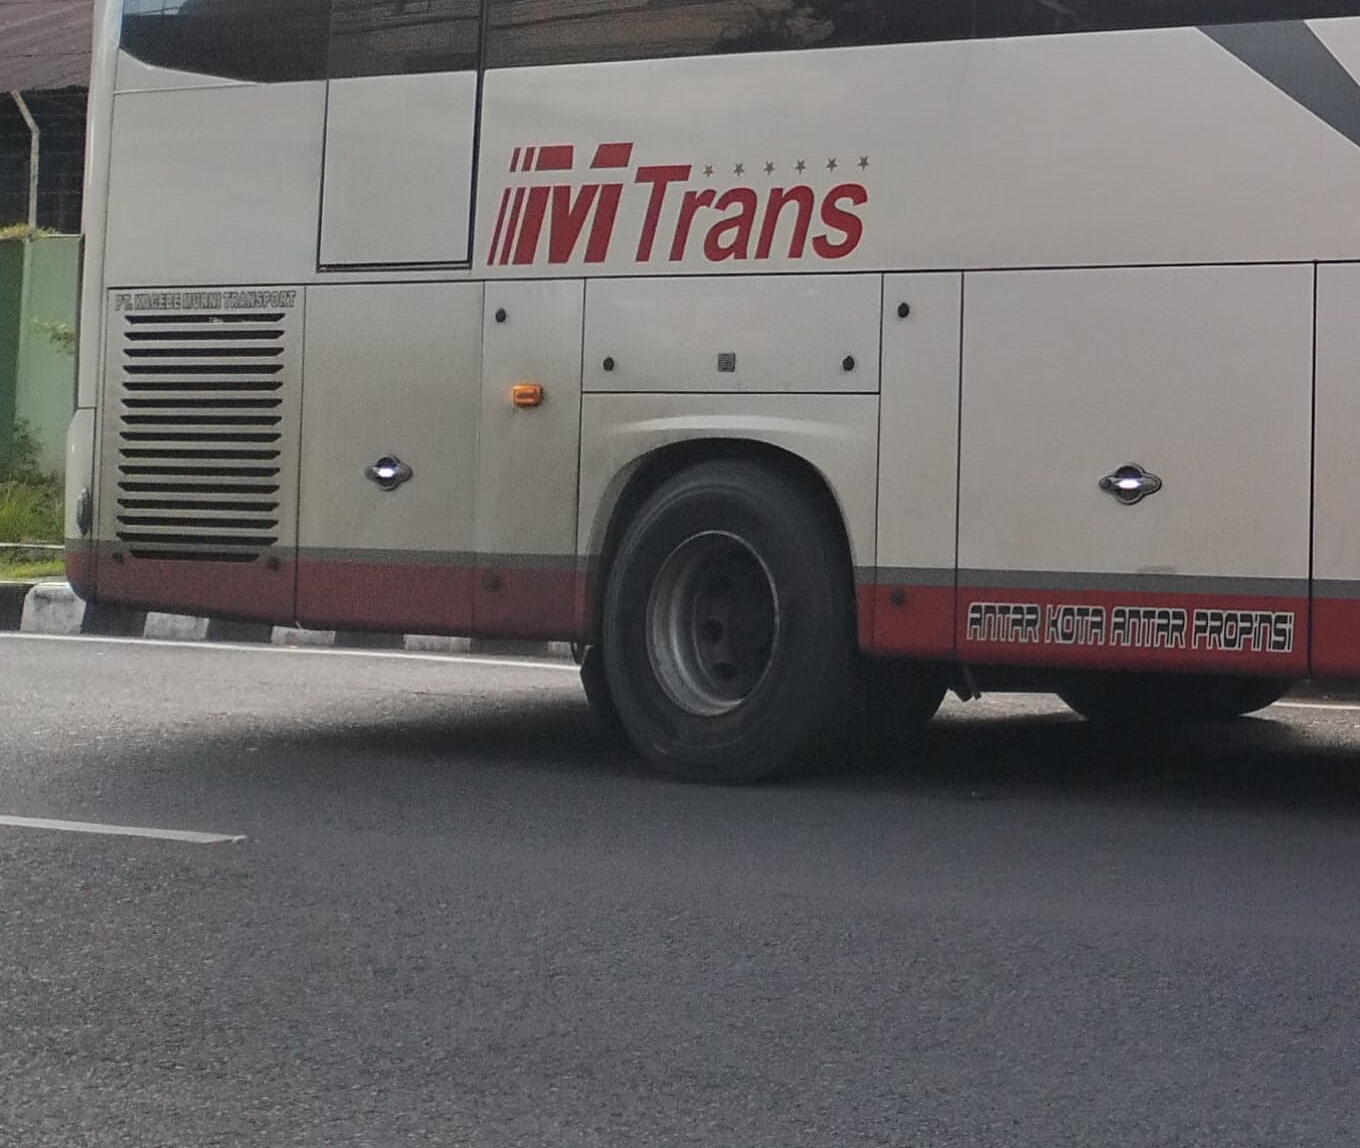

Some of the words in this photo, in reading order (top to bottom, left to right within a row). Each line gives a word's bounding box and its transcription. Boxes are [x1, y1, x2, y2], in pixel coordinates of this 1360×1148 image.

[634, 164, 869, 263] Trans
[223, 290, 296, 309] TRANSPORT
[966, 602, 1041, 644] ANTAR
[1044, 604, 1106, 646] KOTA
[1110, 606, 1188, 648] ANTAR
